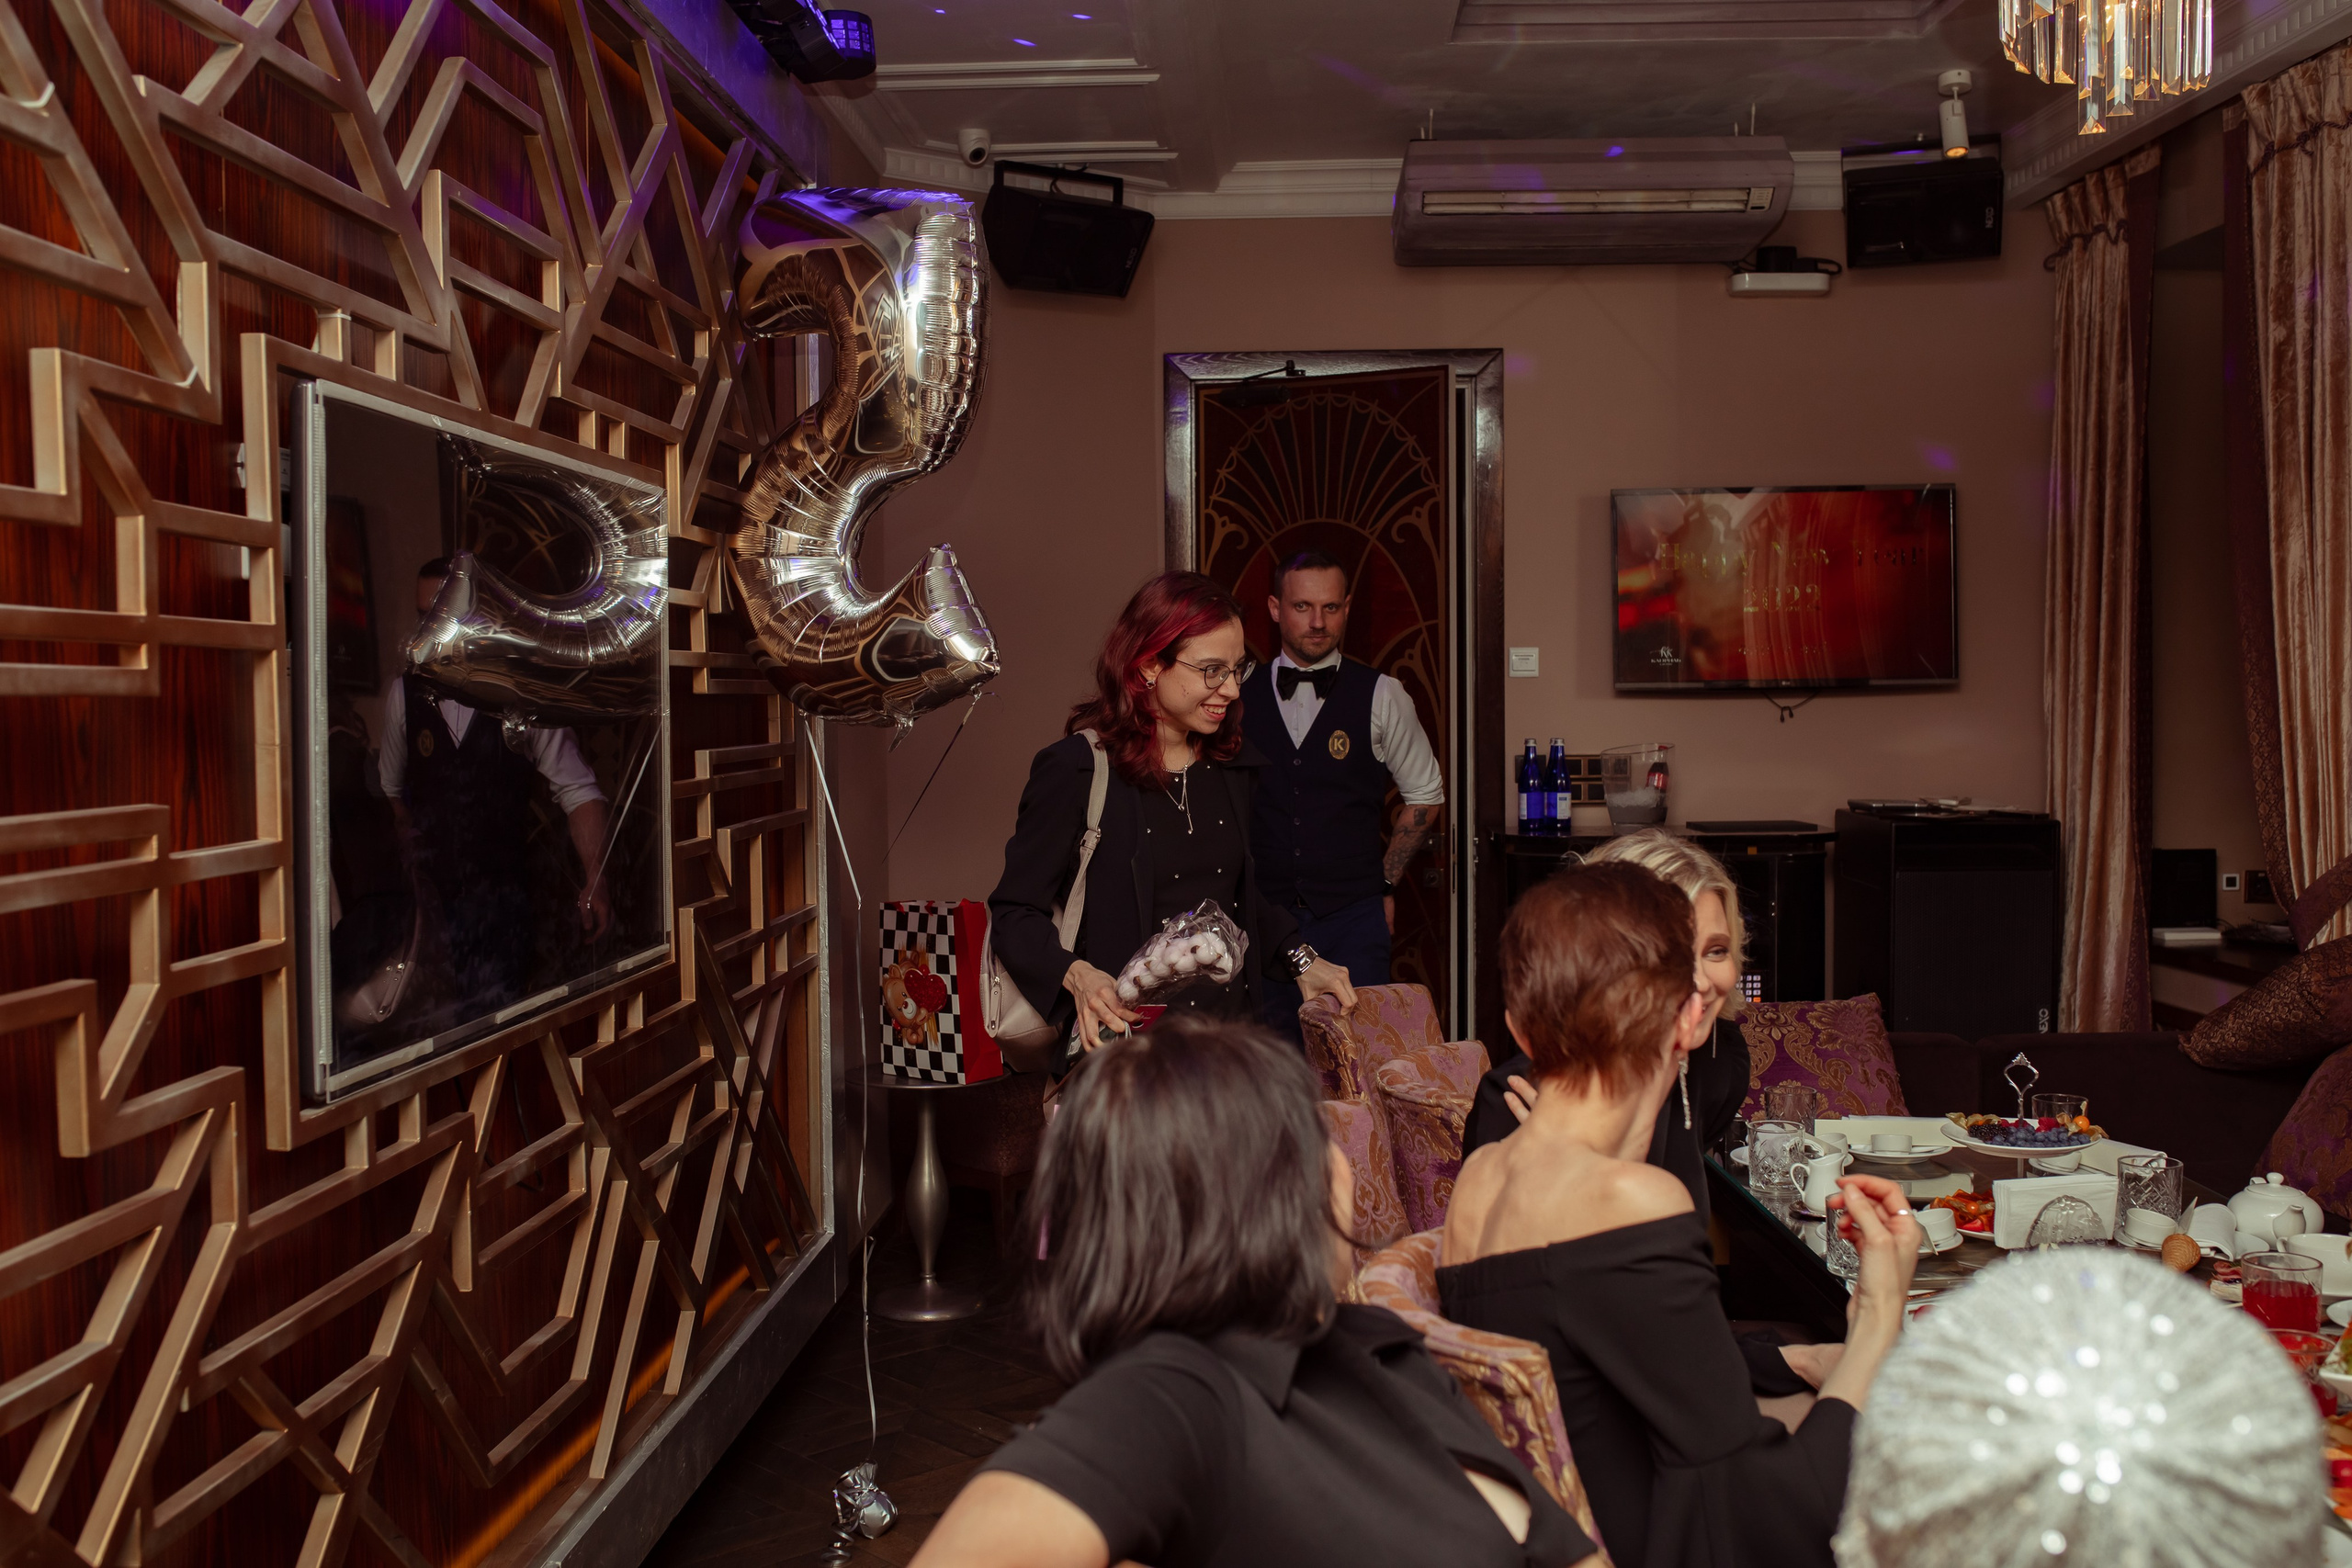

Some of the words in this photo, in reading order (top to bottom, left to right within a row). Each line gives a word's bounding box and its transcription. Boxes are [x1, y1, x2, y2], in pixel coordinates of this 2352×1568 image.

[1661, 543, 1757, 579] Happy
[1771, 541, 1833, 567] New
[1743, 583, 1820, 613] 2022
[1334, 739, 1344, 750] K
